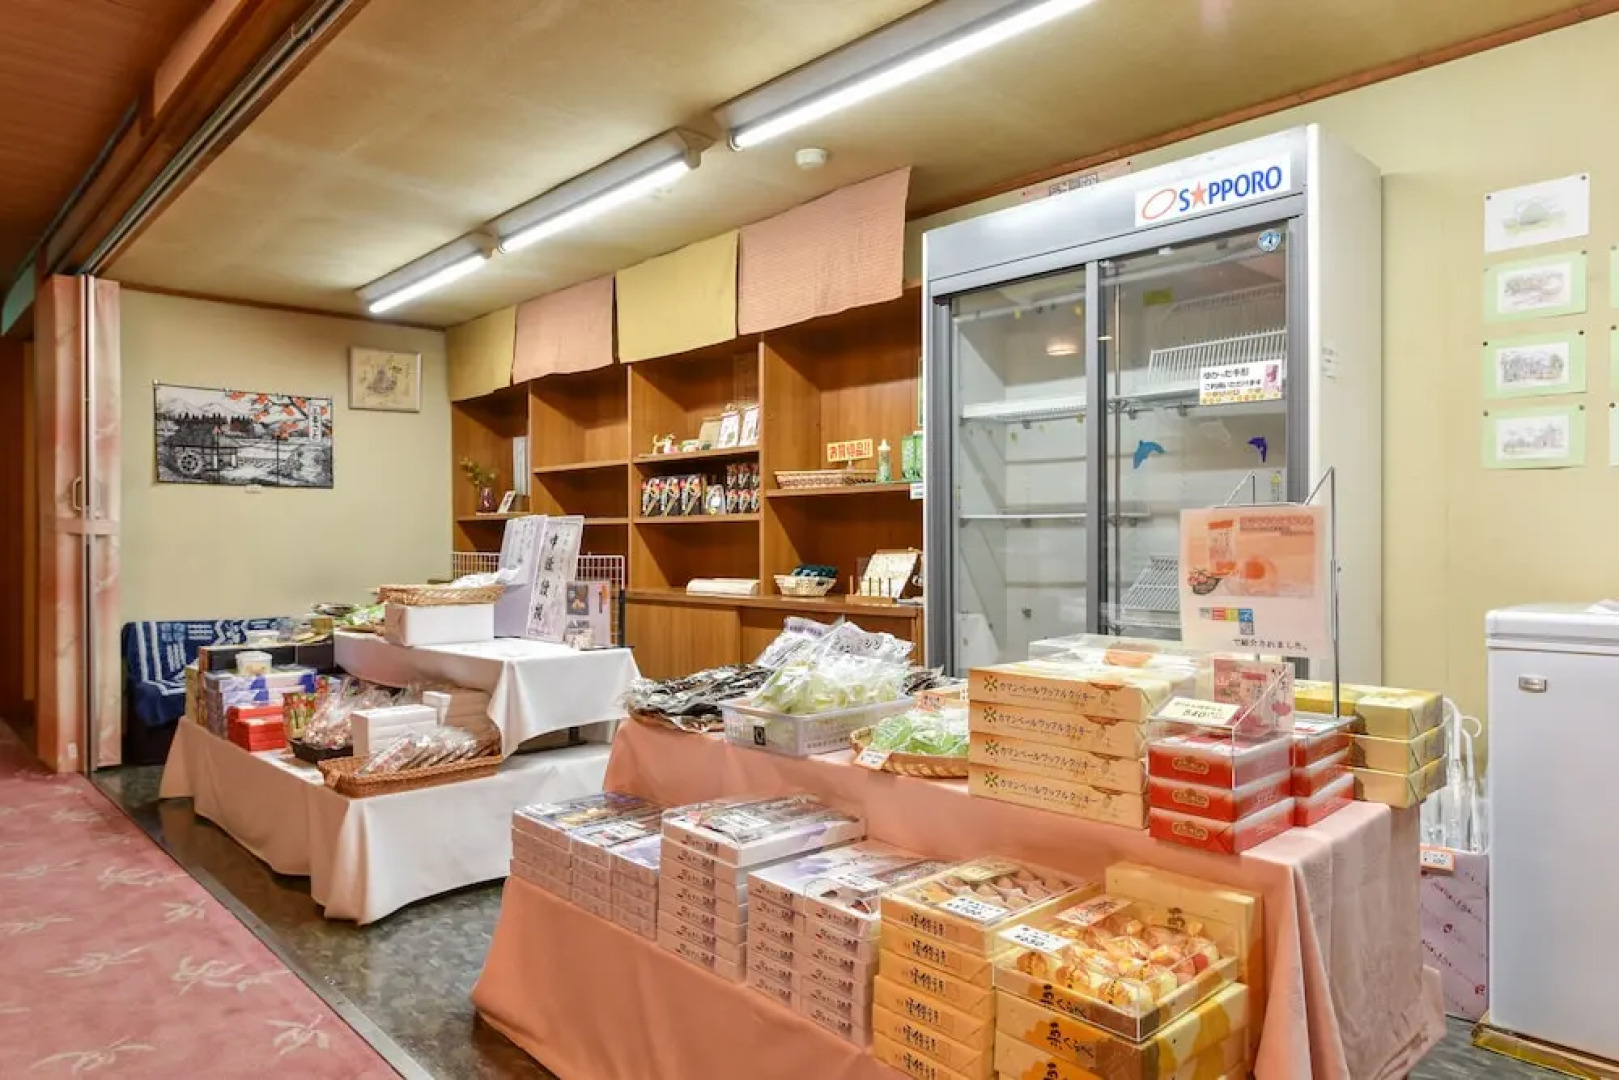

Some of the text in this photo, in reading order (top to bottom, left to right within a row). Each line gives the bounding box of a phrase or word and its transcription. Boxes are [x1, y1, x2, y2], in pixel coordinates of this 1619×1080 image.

[1179, 165, 1283, 212] SAPPORO
[1232, 638, 1308, 651] で紹介されました。
